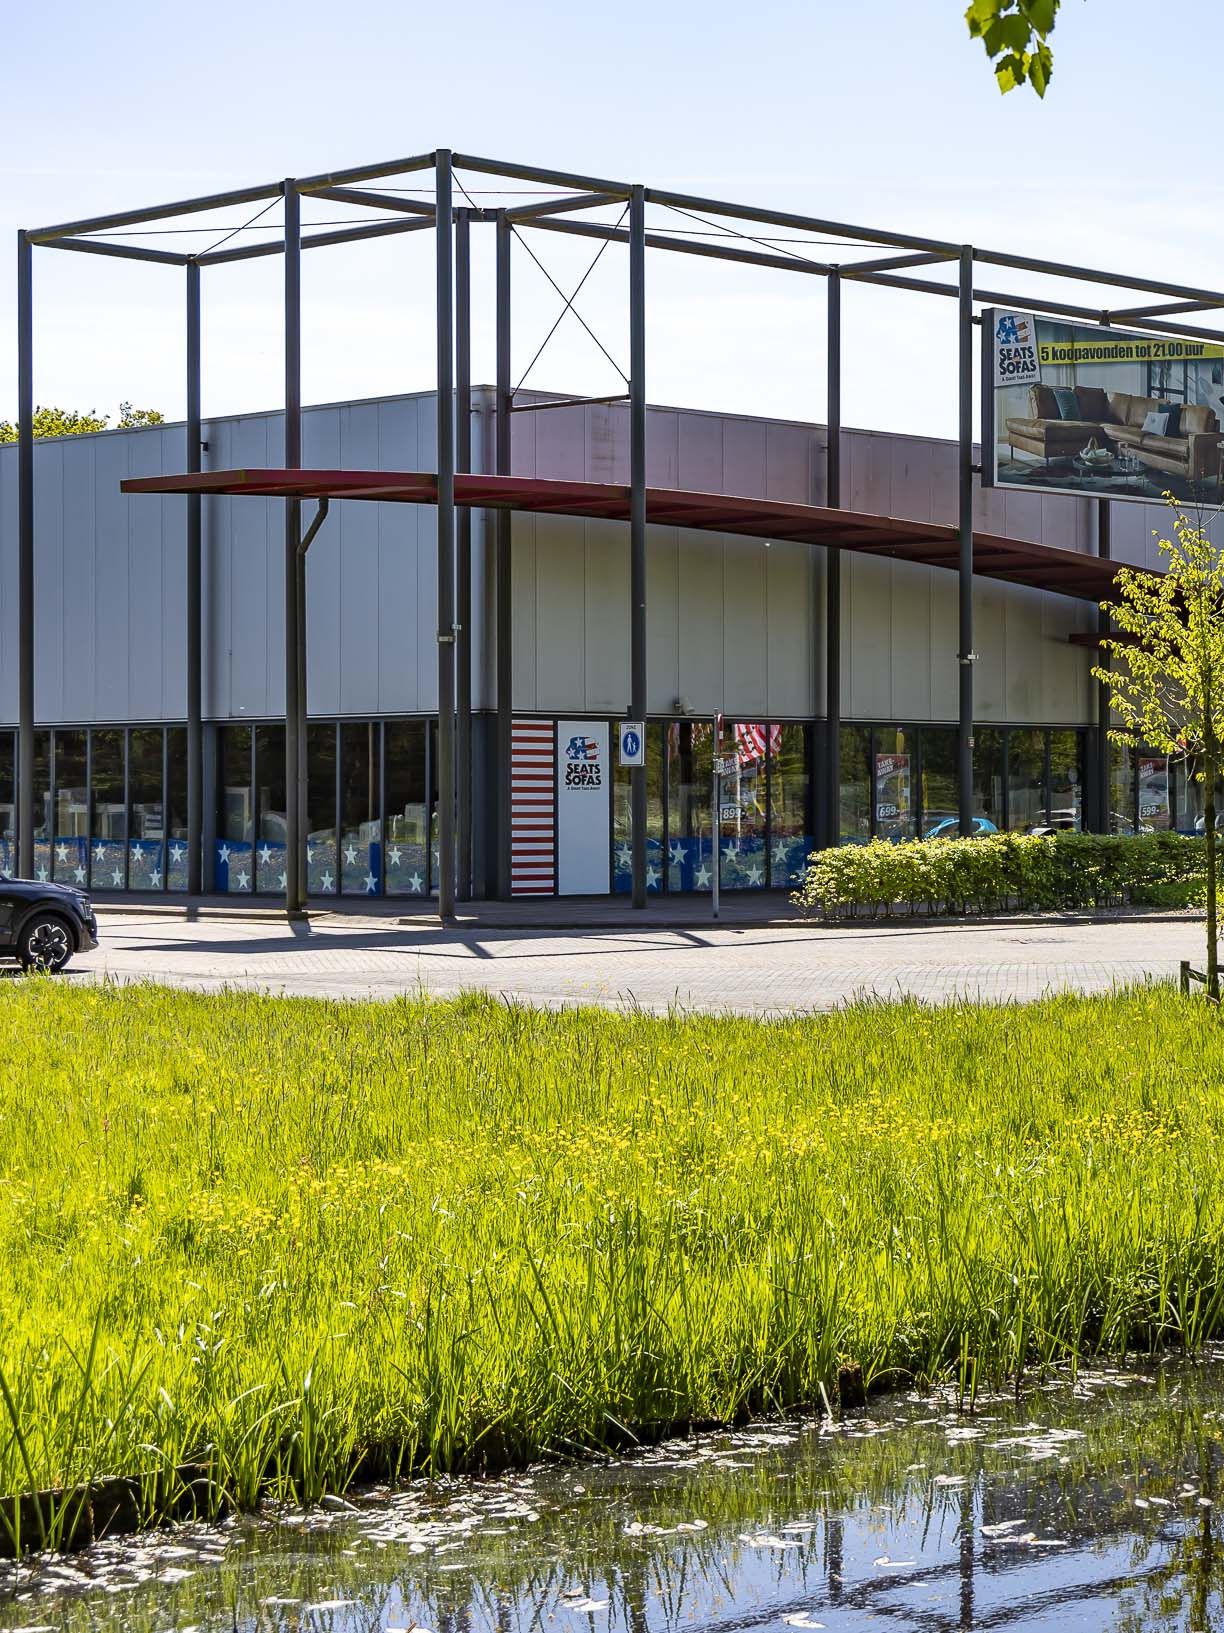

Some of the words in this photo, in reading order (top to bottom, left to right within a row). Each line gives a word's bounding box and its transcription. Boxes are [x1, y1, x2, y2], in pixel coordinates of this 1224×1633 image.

[999, 346, 1034, 361] SEATS
[1041, 347, 1049, 361] 5
[1052, 345, 1133, 362] koopavonden
[1136, 344, 1152, 358] tot
[1153, 343, 1182, 357] 21.00
[1185, 343, 1204, 356] uur
[999, 360, 1037, 375] SOFAS
[567, 763, 600, 775] SEATS
[566, 773, 601, 785] SOFAS
